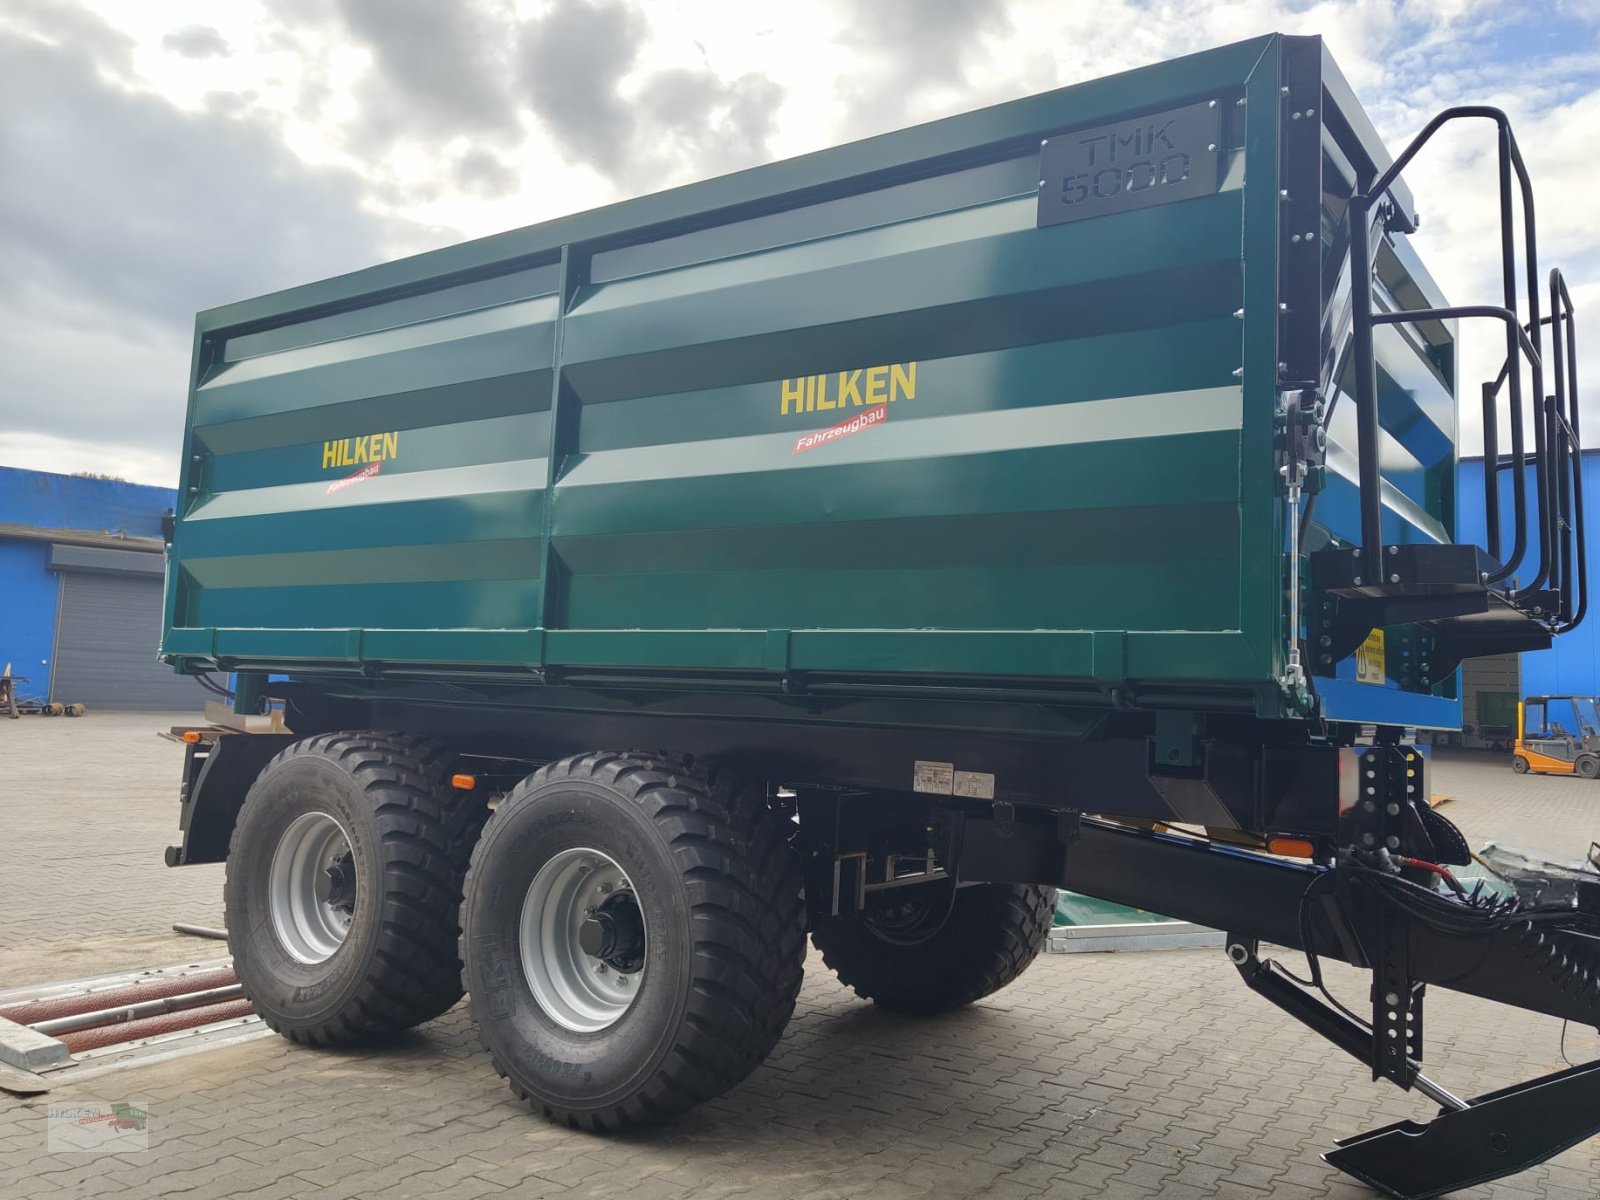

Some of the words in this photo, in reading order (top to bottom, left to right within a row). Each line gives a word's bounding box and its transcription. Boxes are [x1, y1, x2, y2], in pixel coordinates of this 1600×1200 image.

[1079, 119, 1176, 166] TMK
[1061, 153, 1190, 205] 5000
[780, 361, 917, 415] HILKEN
[322, 431, 399, 469] HILKEN
[796, 408, 885, 450] Fahrzeugbau
